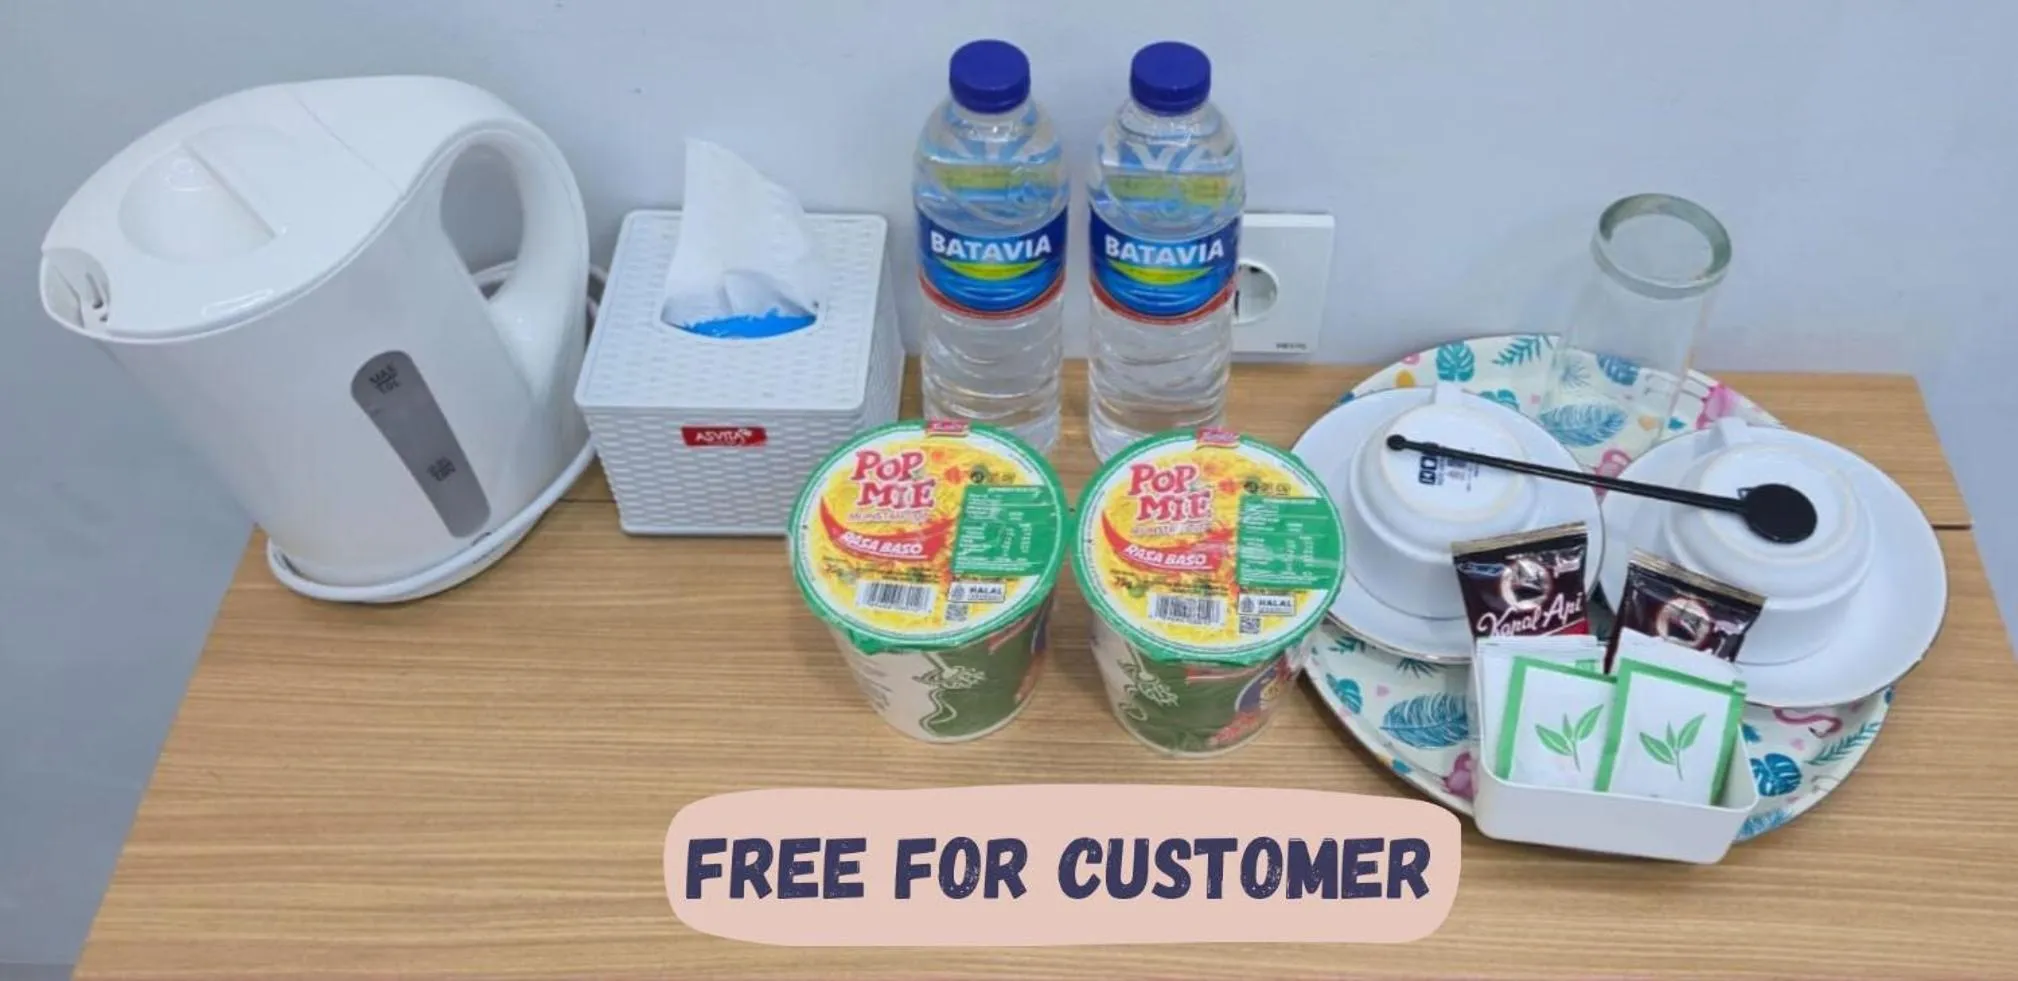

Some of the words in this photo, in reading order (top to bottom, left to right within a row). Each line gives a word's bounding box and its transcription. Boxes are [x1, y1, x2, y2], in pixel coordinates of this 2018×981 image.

[930, 230, 1052, 261] BATAVIA
[1104, 234, 1225, 265] BATAVIA
[851, 449, 924, 482] POP
[1127, 462, 1197, 495] POP
[857, 479, 936, 510] MIE
[1136, 490, 1211, 521] MIE
[843, 531, 880, 551] RASA
[879, 542, 924, 555] BASO
[1124, 543, 1164, 563] RASA
[1163, 552, 1208, 565] BASO
